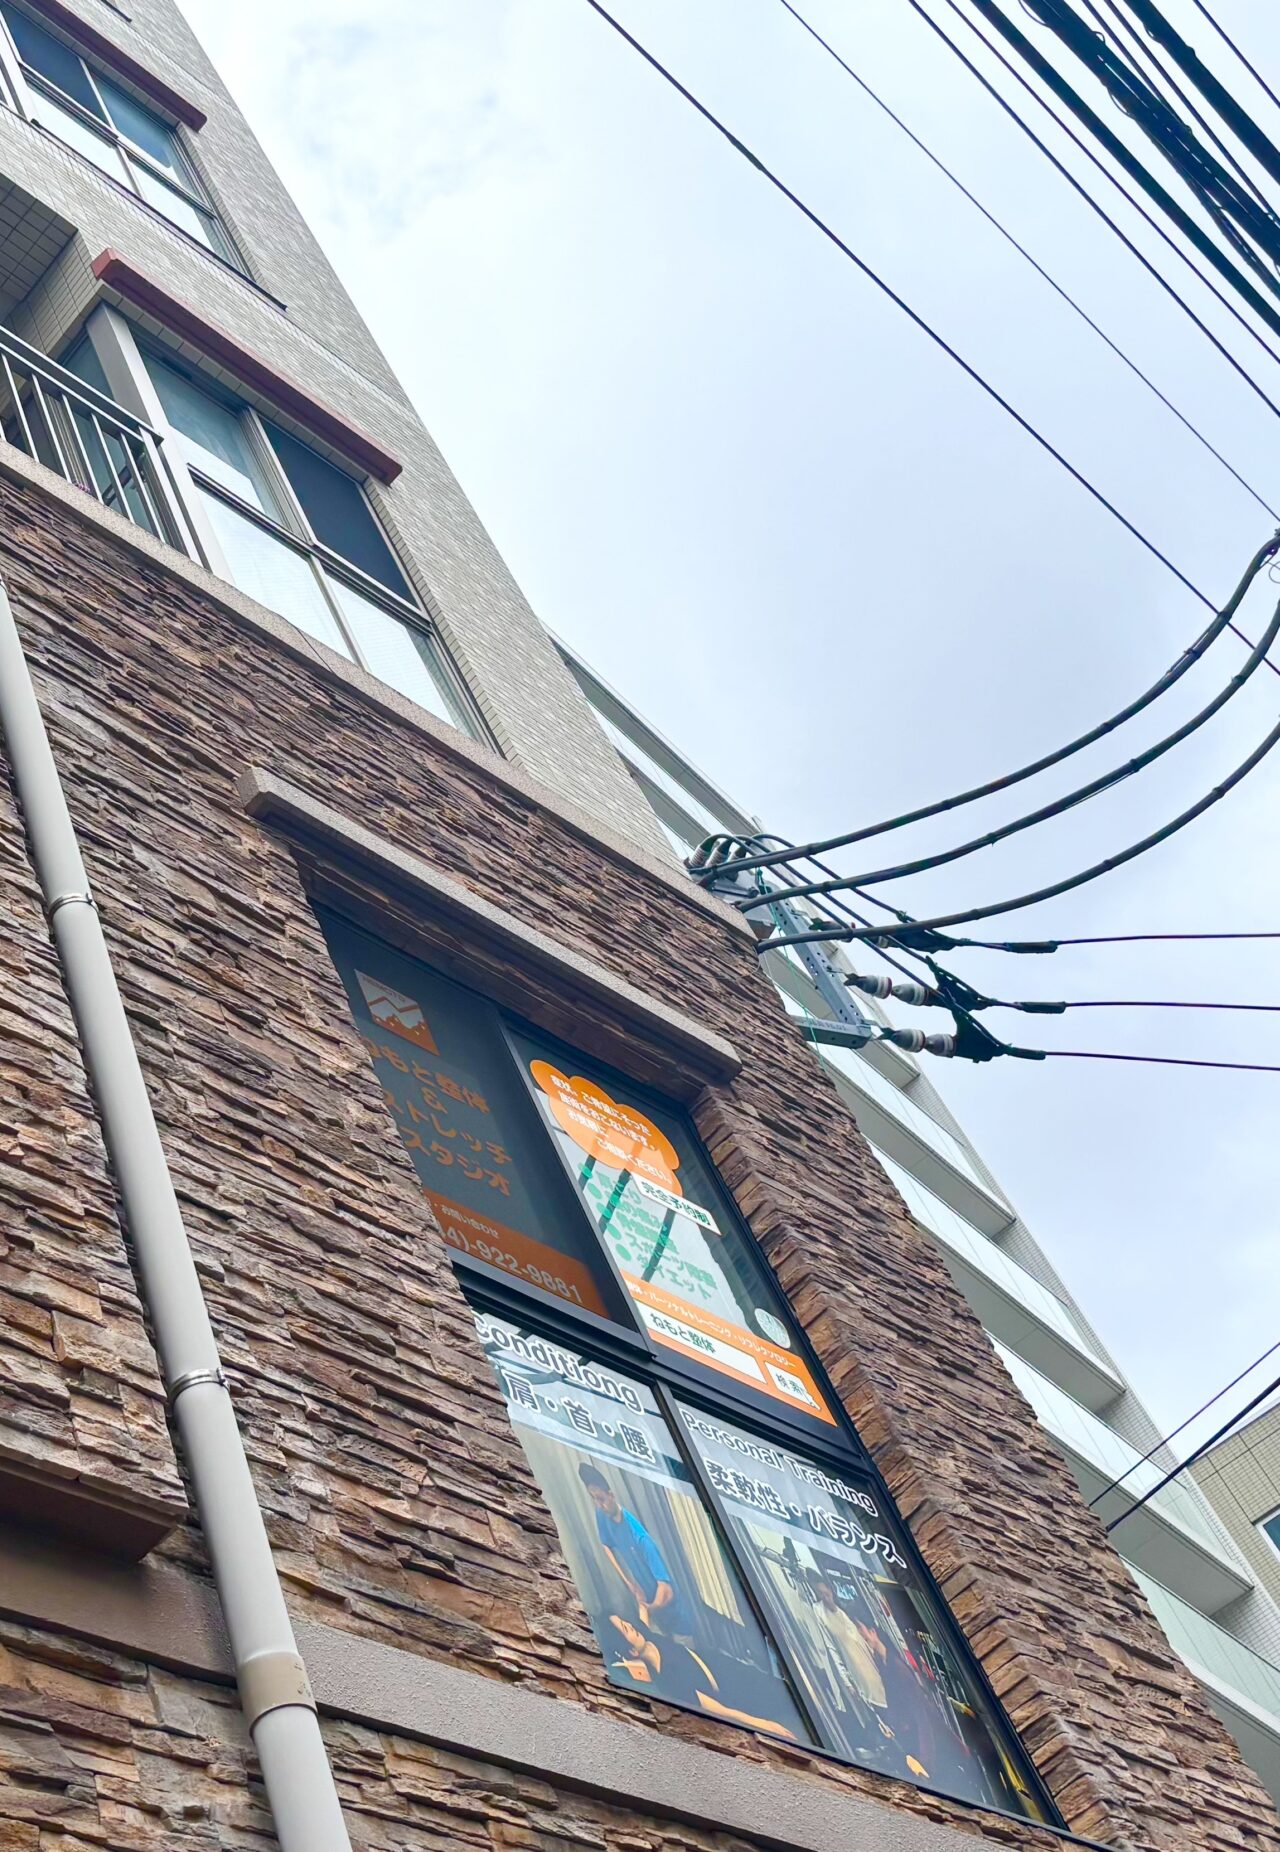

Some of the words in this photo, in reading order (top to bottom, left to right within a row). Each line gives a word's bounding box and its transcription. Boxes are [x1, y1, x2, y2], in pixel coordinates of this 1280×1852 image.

[399, 1124, 511, 1198] スタジオ
[649, 1312, 717, 1354] ねもと整体
[500, 1368, 656, 1464] 肩・首・腰
[678, 1407, 785, 1473] Personal
[784, 1454, 879, 1518] Training
[703, 1458, 909, 1570] 柔軟性・バランス
